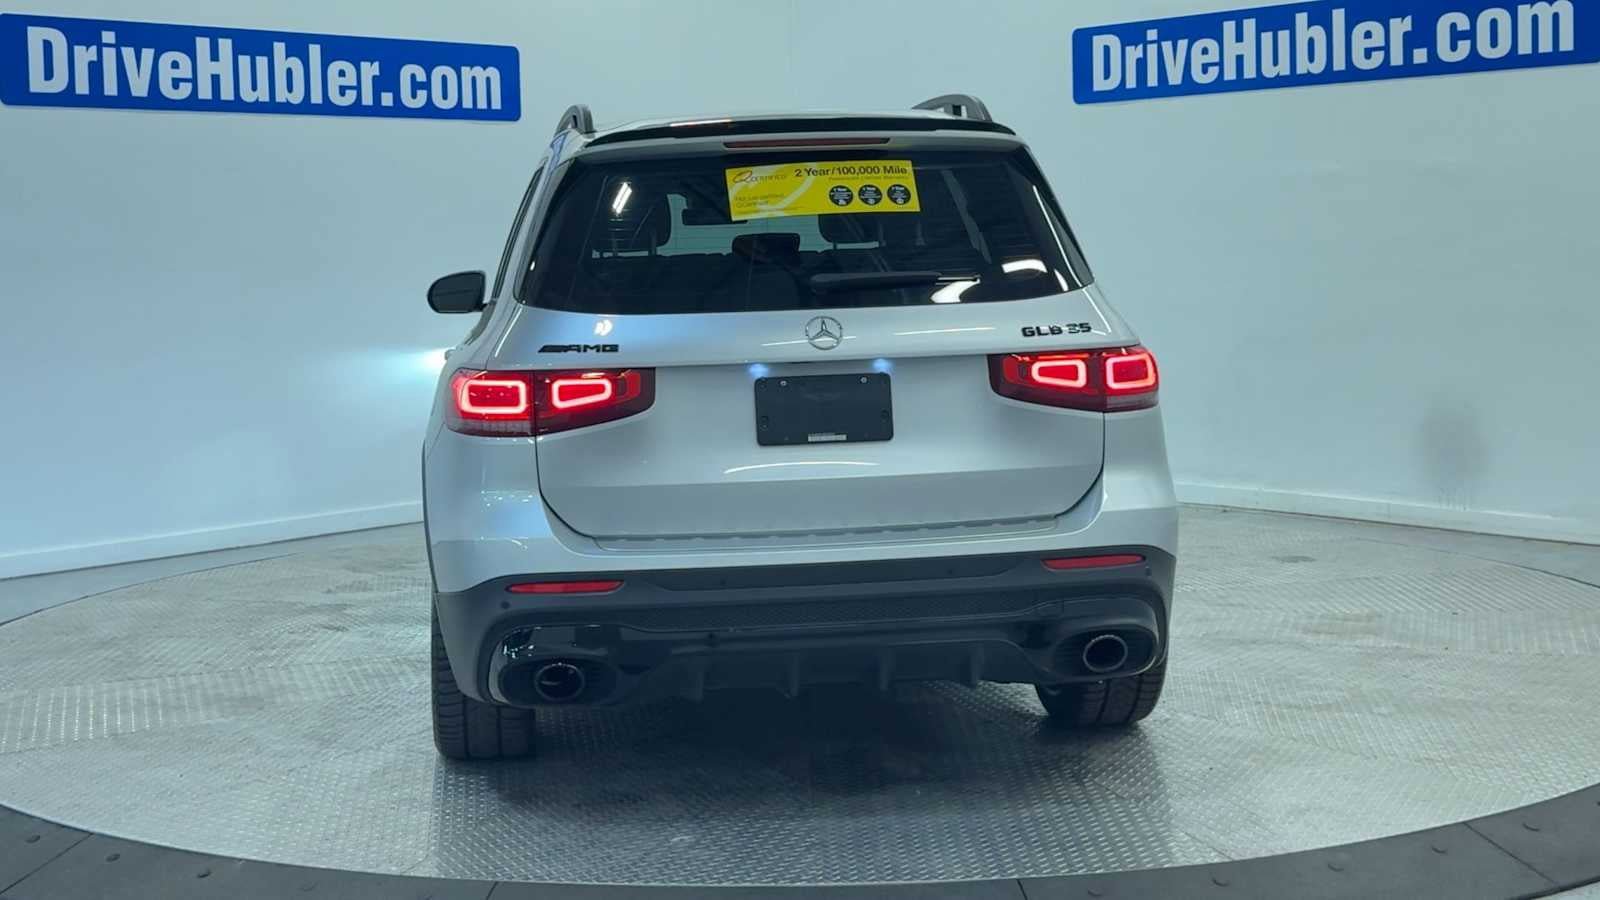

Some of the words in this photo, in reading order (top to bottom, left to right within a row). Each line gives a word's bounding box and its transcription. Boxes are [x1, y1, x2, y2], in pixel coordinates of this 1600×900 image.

[1092, 0, 1575, 91] DriveHubler.com
[26, 25, 503, 110] DriveHubler.com
[794, 168, 802, 177] 2
[804, 165, 880, 178] Year/100,000
[883, 164, 908, 175] Mile
[1021, 325, 1063, 338] GLB
[1065, 322, 1092, 334] 35
[562, 344, 619, 353] AMG
